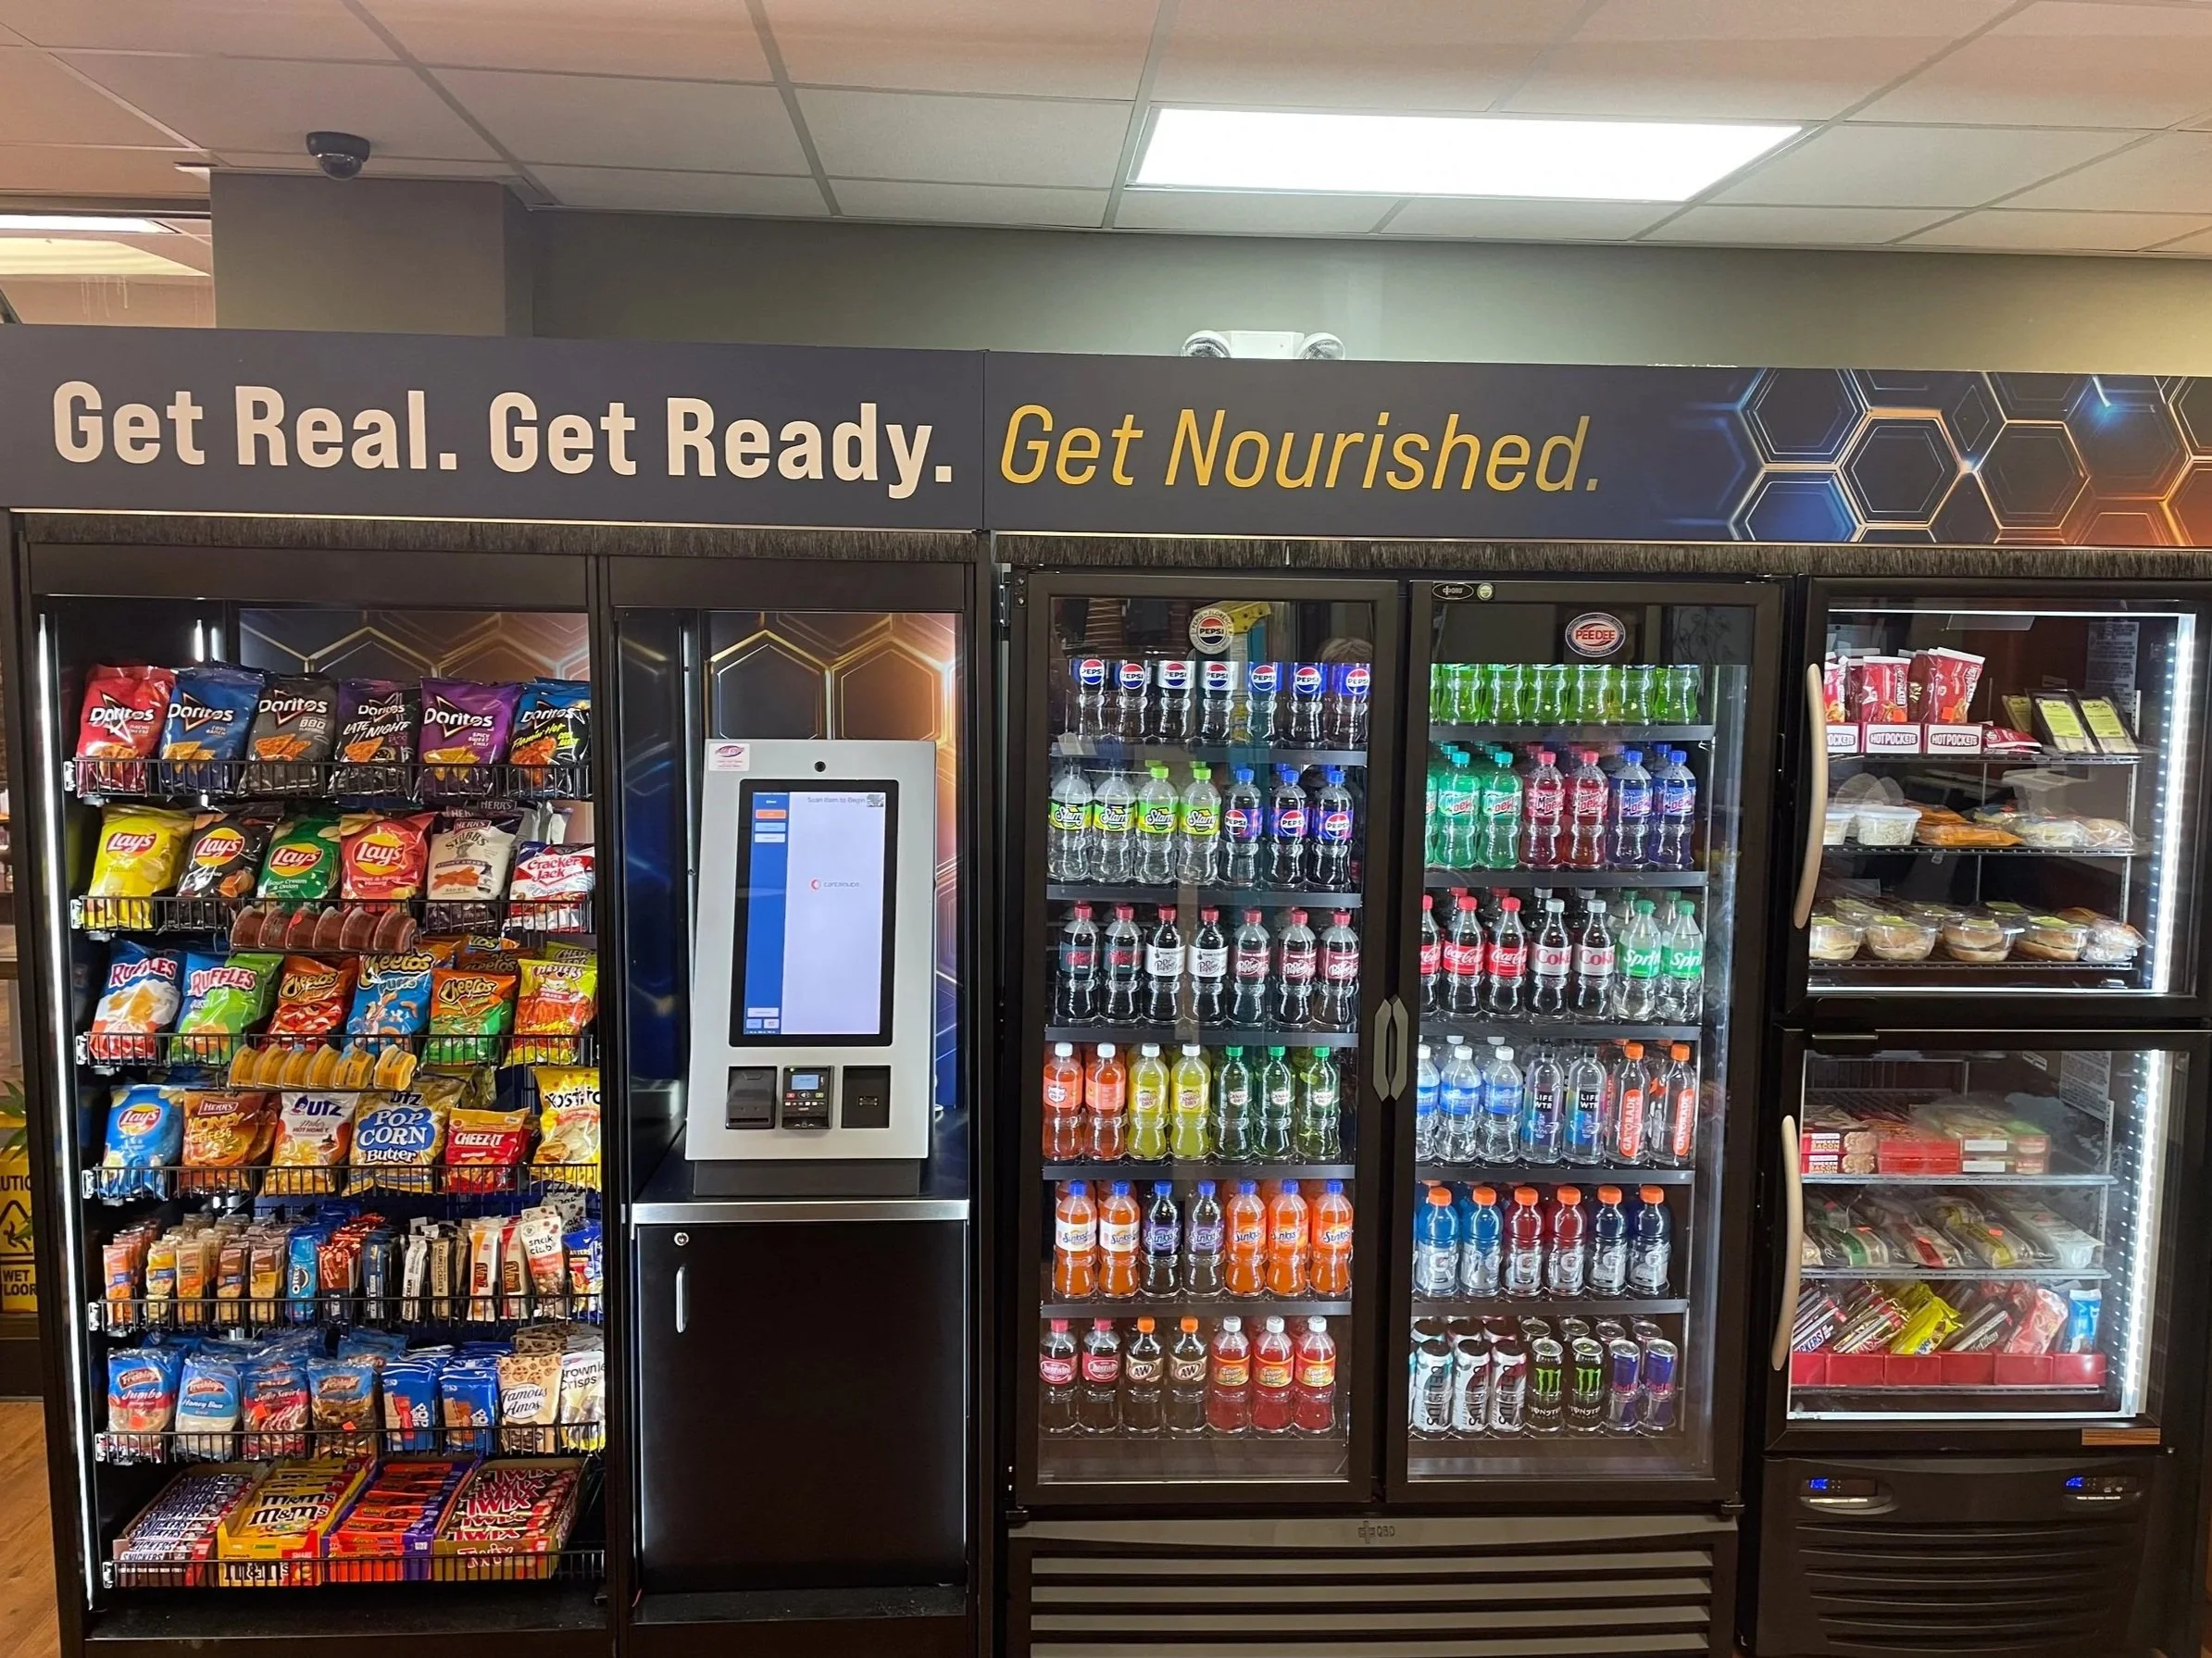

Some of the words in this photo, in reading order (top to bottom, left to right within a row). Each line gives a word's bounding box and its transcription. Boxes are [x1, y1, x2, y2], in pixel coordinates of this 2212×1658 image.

[54, 380, 205, 466] Get
[236, 386, 457, 471] Real.
[490, 392, 637, 477] Get
[667, 398, 954, 500] Ready.
[1001, 405, 1138, 488] Get
[1165, 409, 1602, 492] Nourished.
[168, 702, 234, 722] Doritos
[258, 699, 329, 716] Doritos
[358, 704, 406, 717] Doritos
[423, 707, 494, 728] Doritos
[343, 721, 369, 737] LATE
[366, 721, 412, 739] NIGHT
[848, 796, 866, 804] Begin
[106, 832, 156, 854] Lay's
[195, 837, 244, 858] Lay's
[270, 849, 322, 870] Lay's
[356, 842, 403, 866] Lay's
[527, 855, 581, 871] Cracker
[534, 865, 566, 882] Jack
[190, 967, 256, 996] RUFFLES
[439, 978, 497, 1004] Cheetos
[202, 1101, 235, 1113] HERR'S
[122, 1109, 159, 1127] Lay's
[374, 1110, 425, 1127] POP
[360, 1127, 427, 1147] CORN
[366, 1148, 416, 1163] Butter
[4, 1269, 31, 1282] WET
[4, 1284, 37, 1296] LOOR
[121, 1390, 163, 1401] Jumbo
[183, 1399, 207, 1410] Honey
[208, 1400, 224, 1409] Bun
[504, 1400, 543, 1417] Amos
[460, 1497, 532, 1518] TWIX
[122, 1552, 164, 1561] SNICKERS
